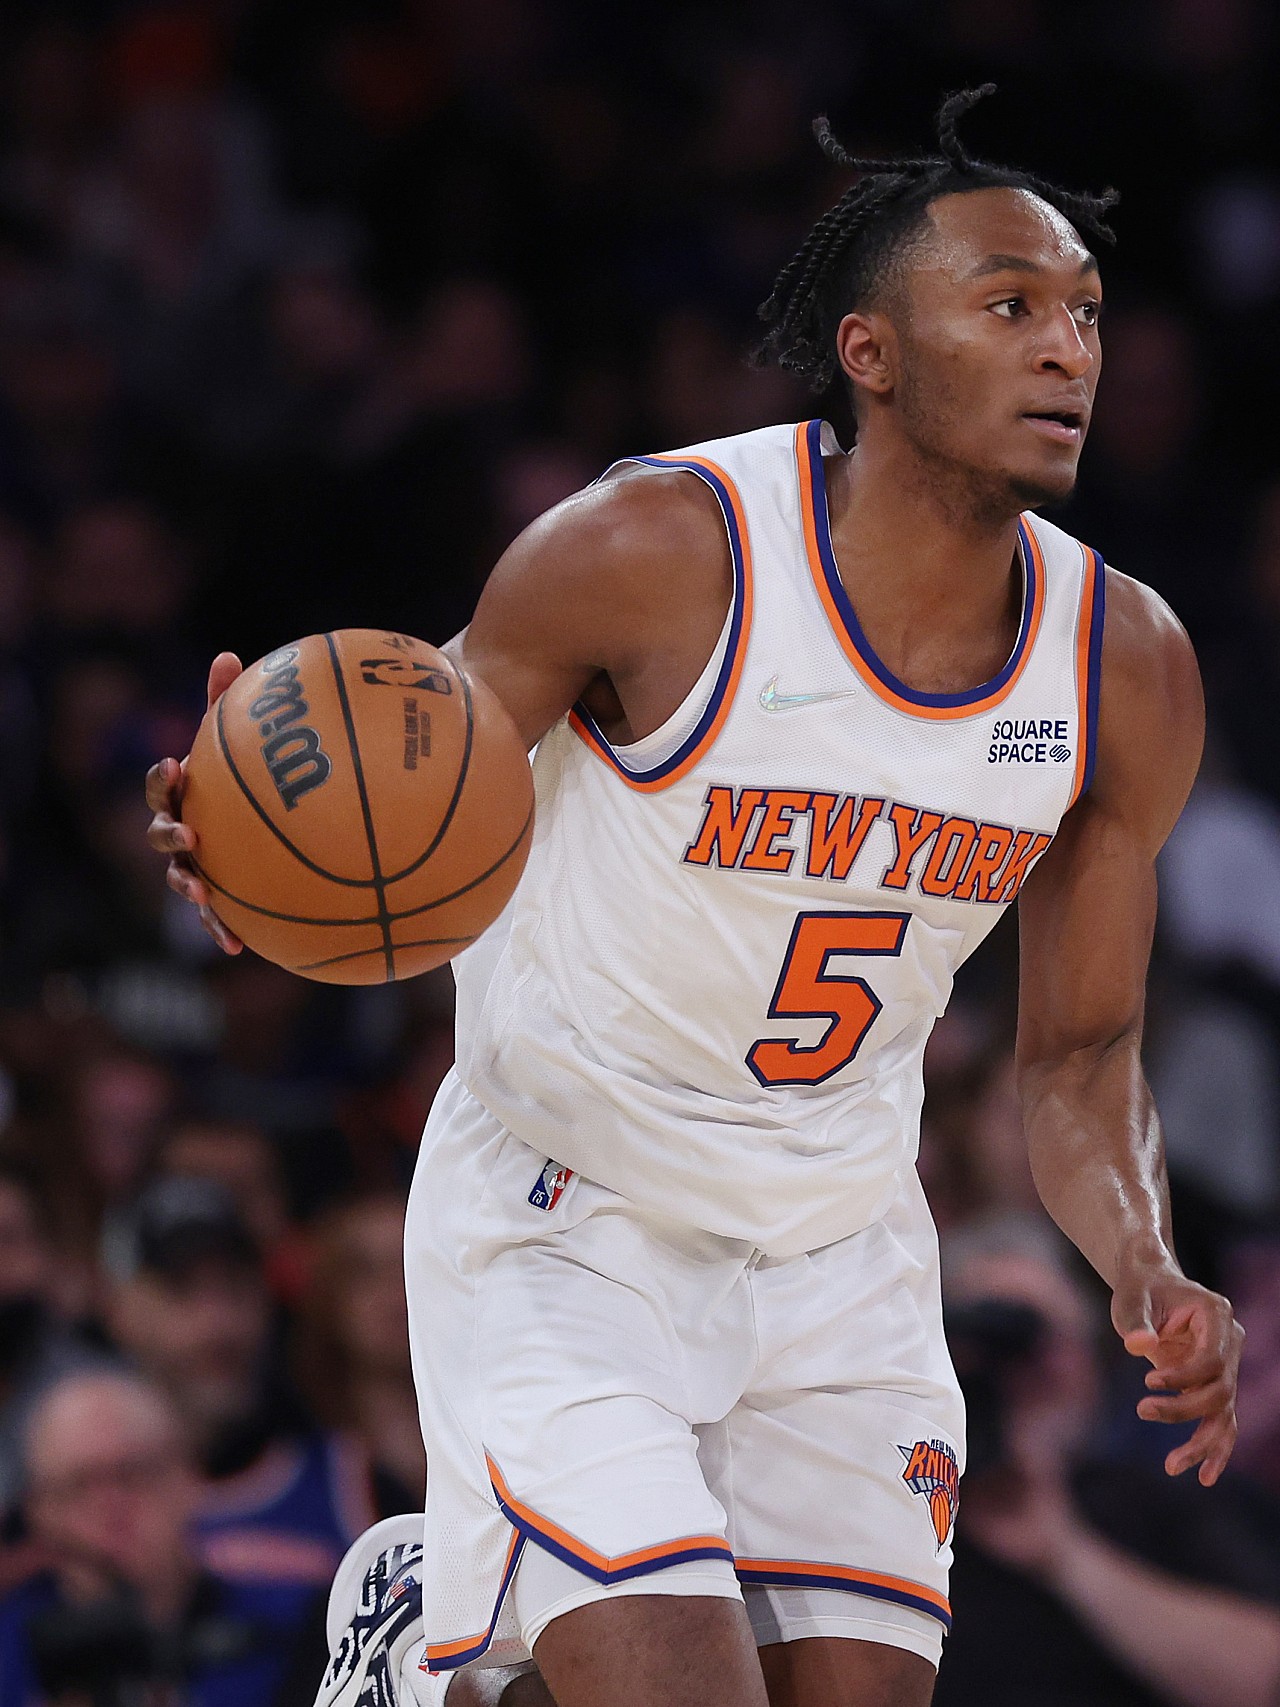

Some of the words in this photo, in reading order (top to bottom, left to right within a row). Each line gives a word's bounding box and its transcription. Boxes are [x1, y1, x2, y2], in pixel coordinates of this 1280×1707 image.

[247, 644, 332, 812] Wilso
[988, 743, 1047, 763] SPACE
[992, 720, 1068, 741] SQUARE
[681, 784, 885, 882] NEW
[880, 802, 1054, 904] YORK
[745, 911, 912, 1087] 5
[532, 1190, 546, 1205] 75
